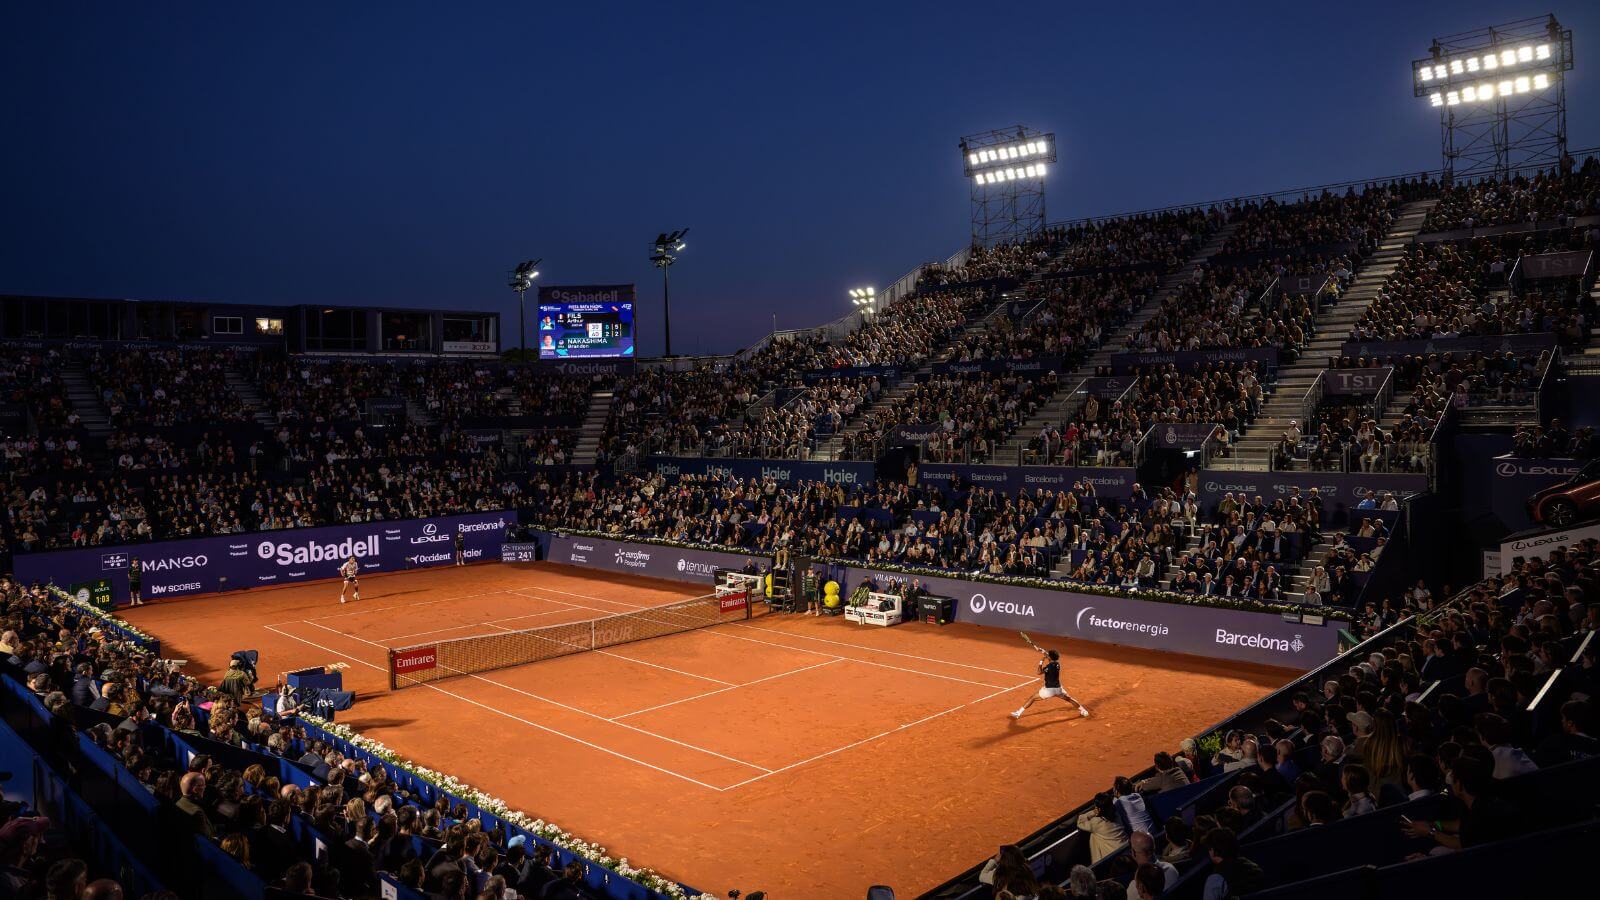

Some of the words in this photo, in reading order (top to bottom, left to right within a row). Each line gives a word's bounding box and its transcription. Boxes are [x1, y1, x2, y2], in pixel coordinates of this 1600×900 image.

[561, 290, 617, 302] Sabadell
[569, 363, 617, 374] Occident
[1011, 362, 1040, 371] Sabadell
[1338, 373, 1377, 388] TST
[906, 431, 931, 440] Sabade
[656, 463, 680, 475] Haier
[761, 466, 791, 480] Haier
[1519, 466, 1581, 476] LEXUS
[824, 469, 857, 483] Haier
[923, 471, 951, 480] Barcelona
[971, 473, 1002, 483] Barcelona
[1025, 474, 1058, 484] Barcelona
[458, 522, 498, 533] Barcelona
[410, 534, 450, 544] LEXUS
[1526, 535, 1569, 549] LEXUS
[276, 535, 380, 566] Sabadell
[625, 551, 650, 562] eurofirms
[419, 552, 451, 563] Occident
[142, 555, 208, 573] MANGO
[686, 560, 719, 574] tennium
[152, 584, 167, 594] bw
[168, 582, 201, 593] SCORES
[96, 594, 110, 604] 1:03
[721, 597, 746, 609] Emirates
[989, 600, 1035, 616] VEOLIA
[1089, 614, 1169, 637] factorenergia
[1215, 629, 1289, 651] Barcelona
[396, 655, 435, 668] Emirates
[317, 698, 334, 708] rtve
